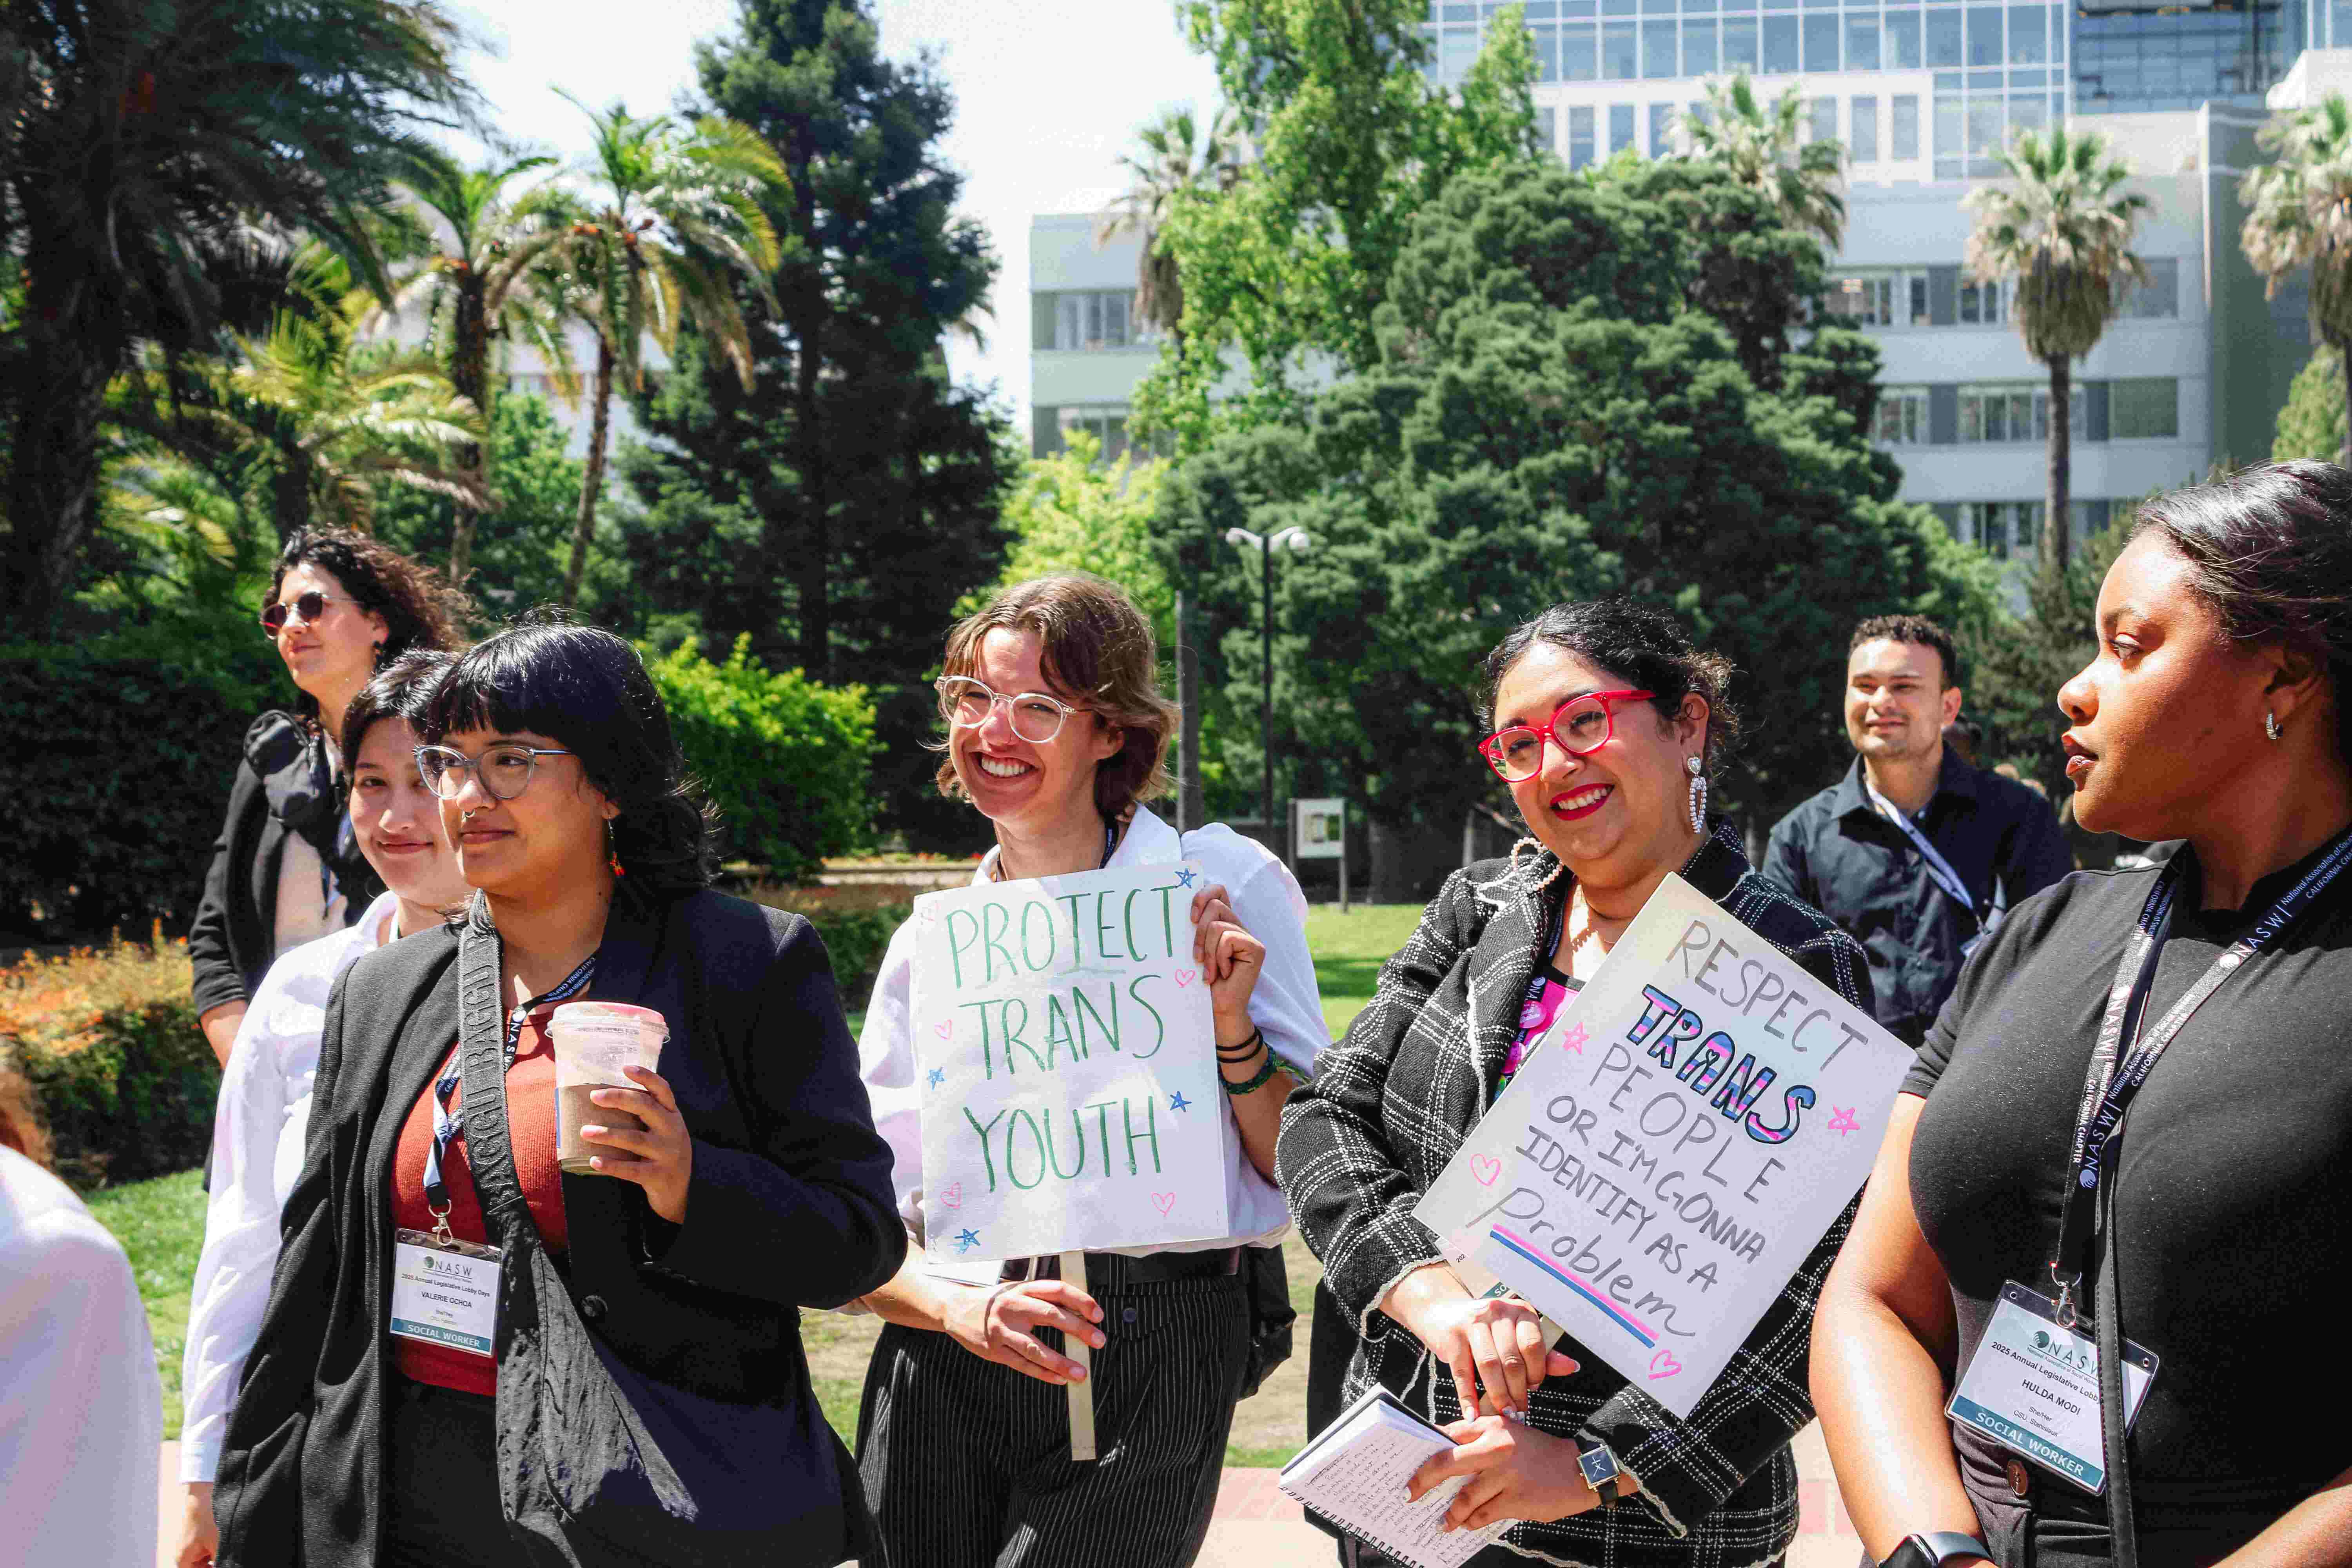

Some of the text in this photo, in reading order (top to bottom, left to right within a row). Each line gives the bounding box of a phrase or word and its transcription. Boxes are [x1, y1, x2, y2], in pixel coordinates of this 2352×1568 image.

[2281, 880, 2306, 906] National
[2305, 854, 2336, 883] Association
[2306, 864, 2342, 898] CALIFORNIA
[947, 885, 1178, 989] PROTECT
[2233, 913, 2285, 958] NASW
[462, 964, 499, 1075] BAGGU
[1666, 919, 1869, 1071] RESPECT
[958, 975, 1164, 1080] TRANS
[2100, 998, 2120, 1051] NASW
[1626, 984, 1816, 1144] TRANS
[2108, 1069, 2132, 1099] National
[2131, 1042, 2163, 1086] CALIFORNIA
[963, 1096, 1161, 1192] YOUTH
[1590, 1042, 1786, 1204] PEOPLE
[2073, 1079, 2096, 1163] CALIFORNIA CHAPTER
[2085, 1109, 2116, 1171] NASW
[1546, 1095, 1766, 1263] OR I'M GONNA
[1515, 1125, 1718, 1293] IDENTIFY AS A
[435, 1261, 472, 1277] NASW
[1456, 1254, 1466, 1263] 202
[415, 1276, 433, 1284] Annual
[434, 1280, 461, 1290] Legislative
[462, 1286, 477, 1295] Lobby
[421, 1291, 472, 1308] VALERIE OCHOA
[407, 1324, 480, 1347] SOCIAL WORKER
[2027, 1347, 2043, 1358] National
[1991, 1341, 2010, 1355] 2025
[2011, 1352, 2038, 1370] Annual
[2039, 1365, 2078, 1390] Legislative
[2022, 1379, 2081, 1416] HULDA MODI
[2029, 1406, 2053, 1422] She/Her
[1976, 1412, 2084, 1477] SOCIAL WORKER
[2029, 1418, 2059, 1437] Stanislaus
